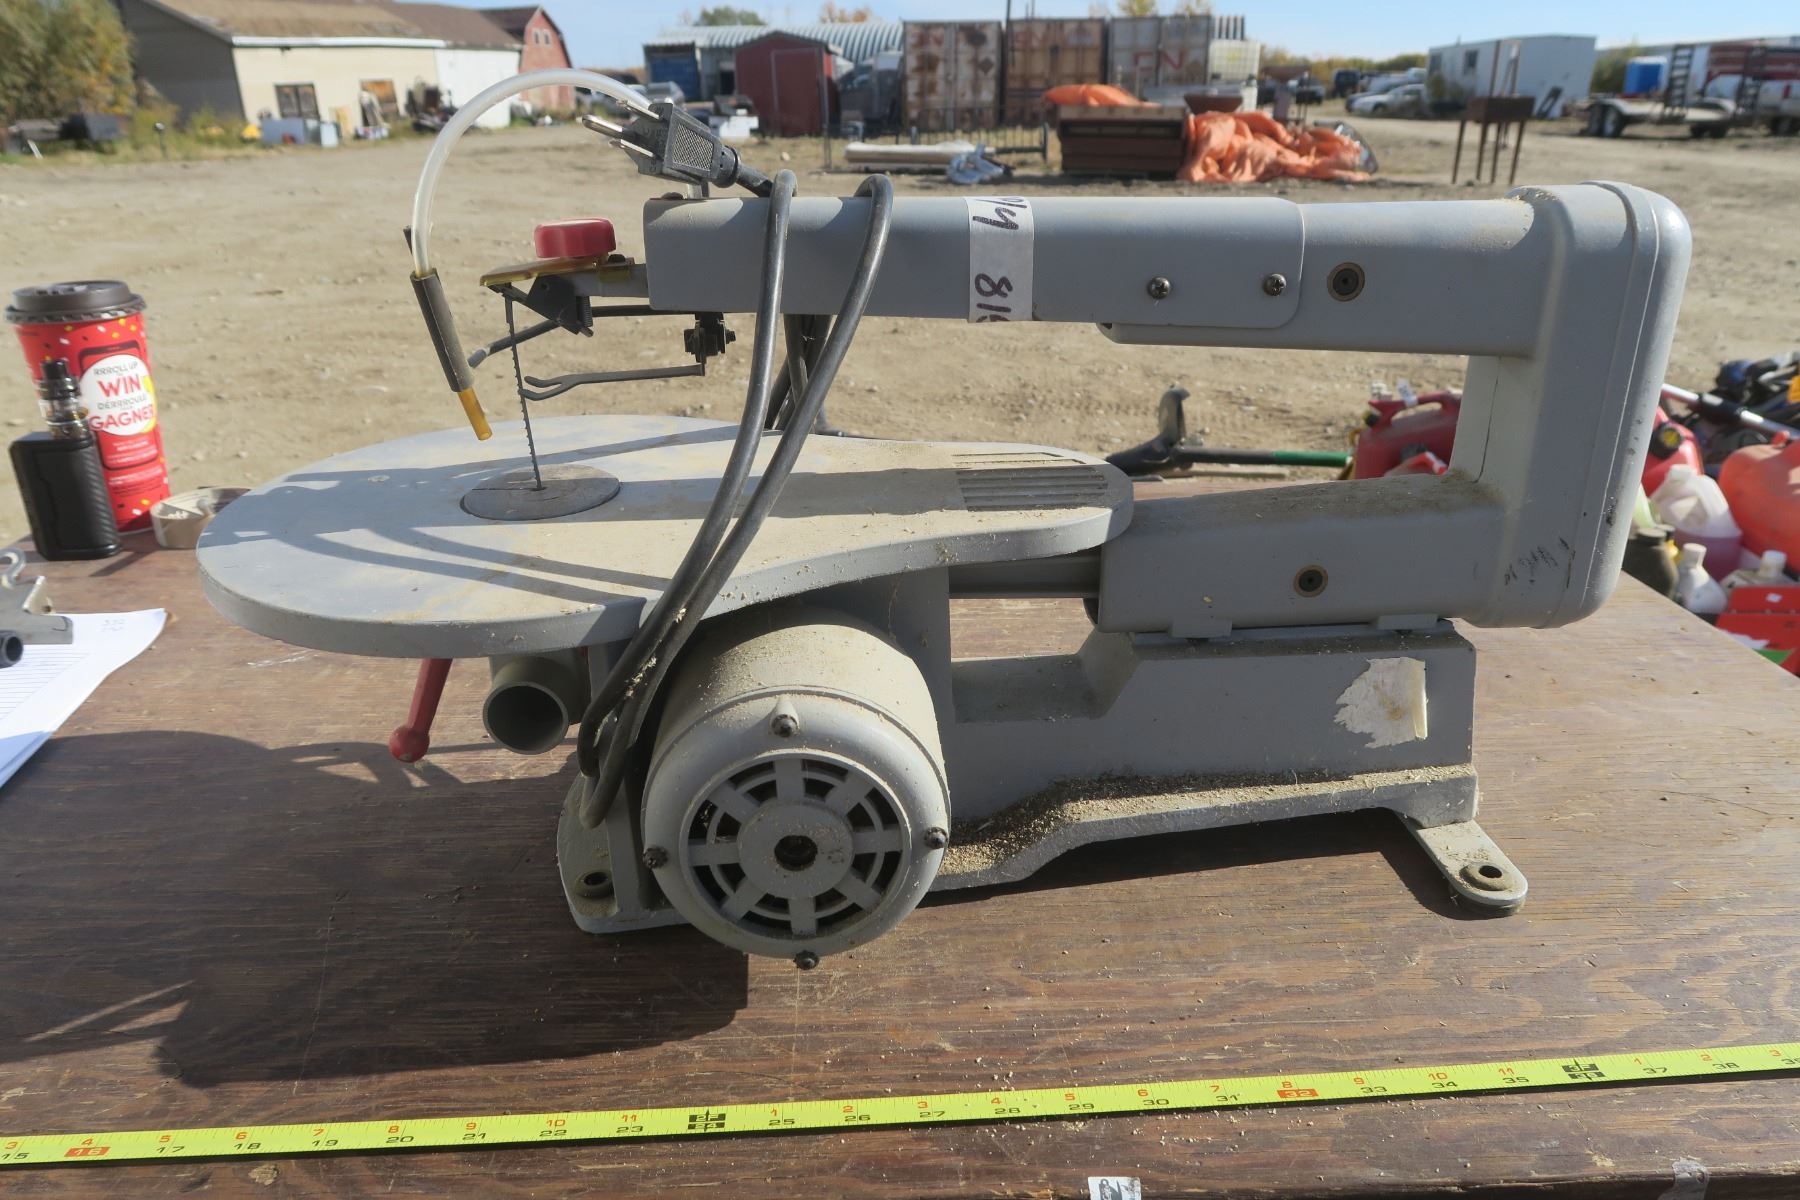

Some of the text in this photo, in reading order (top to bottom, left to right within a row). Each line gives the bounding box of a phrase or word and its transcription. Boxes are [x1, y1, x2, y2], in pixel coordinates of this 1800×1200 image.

[97, 374, 141, 397] WIN
[2, 1152, 30, 1160] 15
[234, 1142, 262, 1150] 18
[462, 1132, 486, 1140] 21
[616, 1126, 644, 1134] 23
[768, 1118, 795, 1126] 25
[844, 1114, 870, 1122] 26
[1360, 1086, 1388, 1094] 33
[1502, 1076, 1530, 1084] 35
[1712, 1062, 1740, 1070] 38
[81, 1138, 93, 1146] 4
[236, 1132, 248, 1140] 6
[466, 1122, 476, 1130] 9
[771, 1108, 778, 1116] 1
[1428, 1072, 1448, 1080] 10
